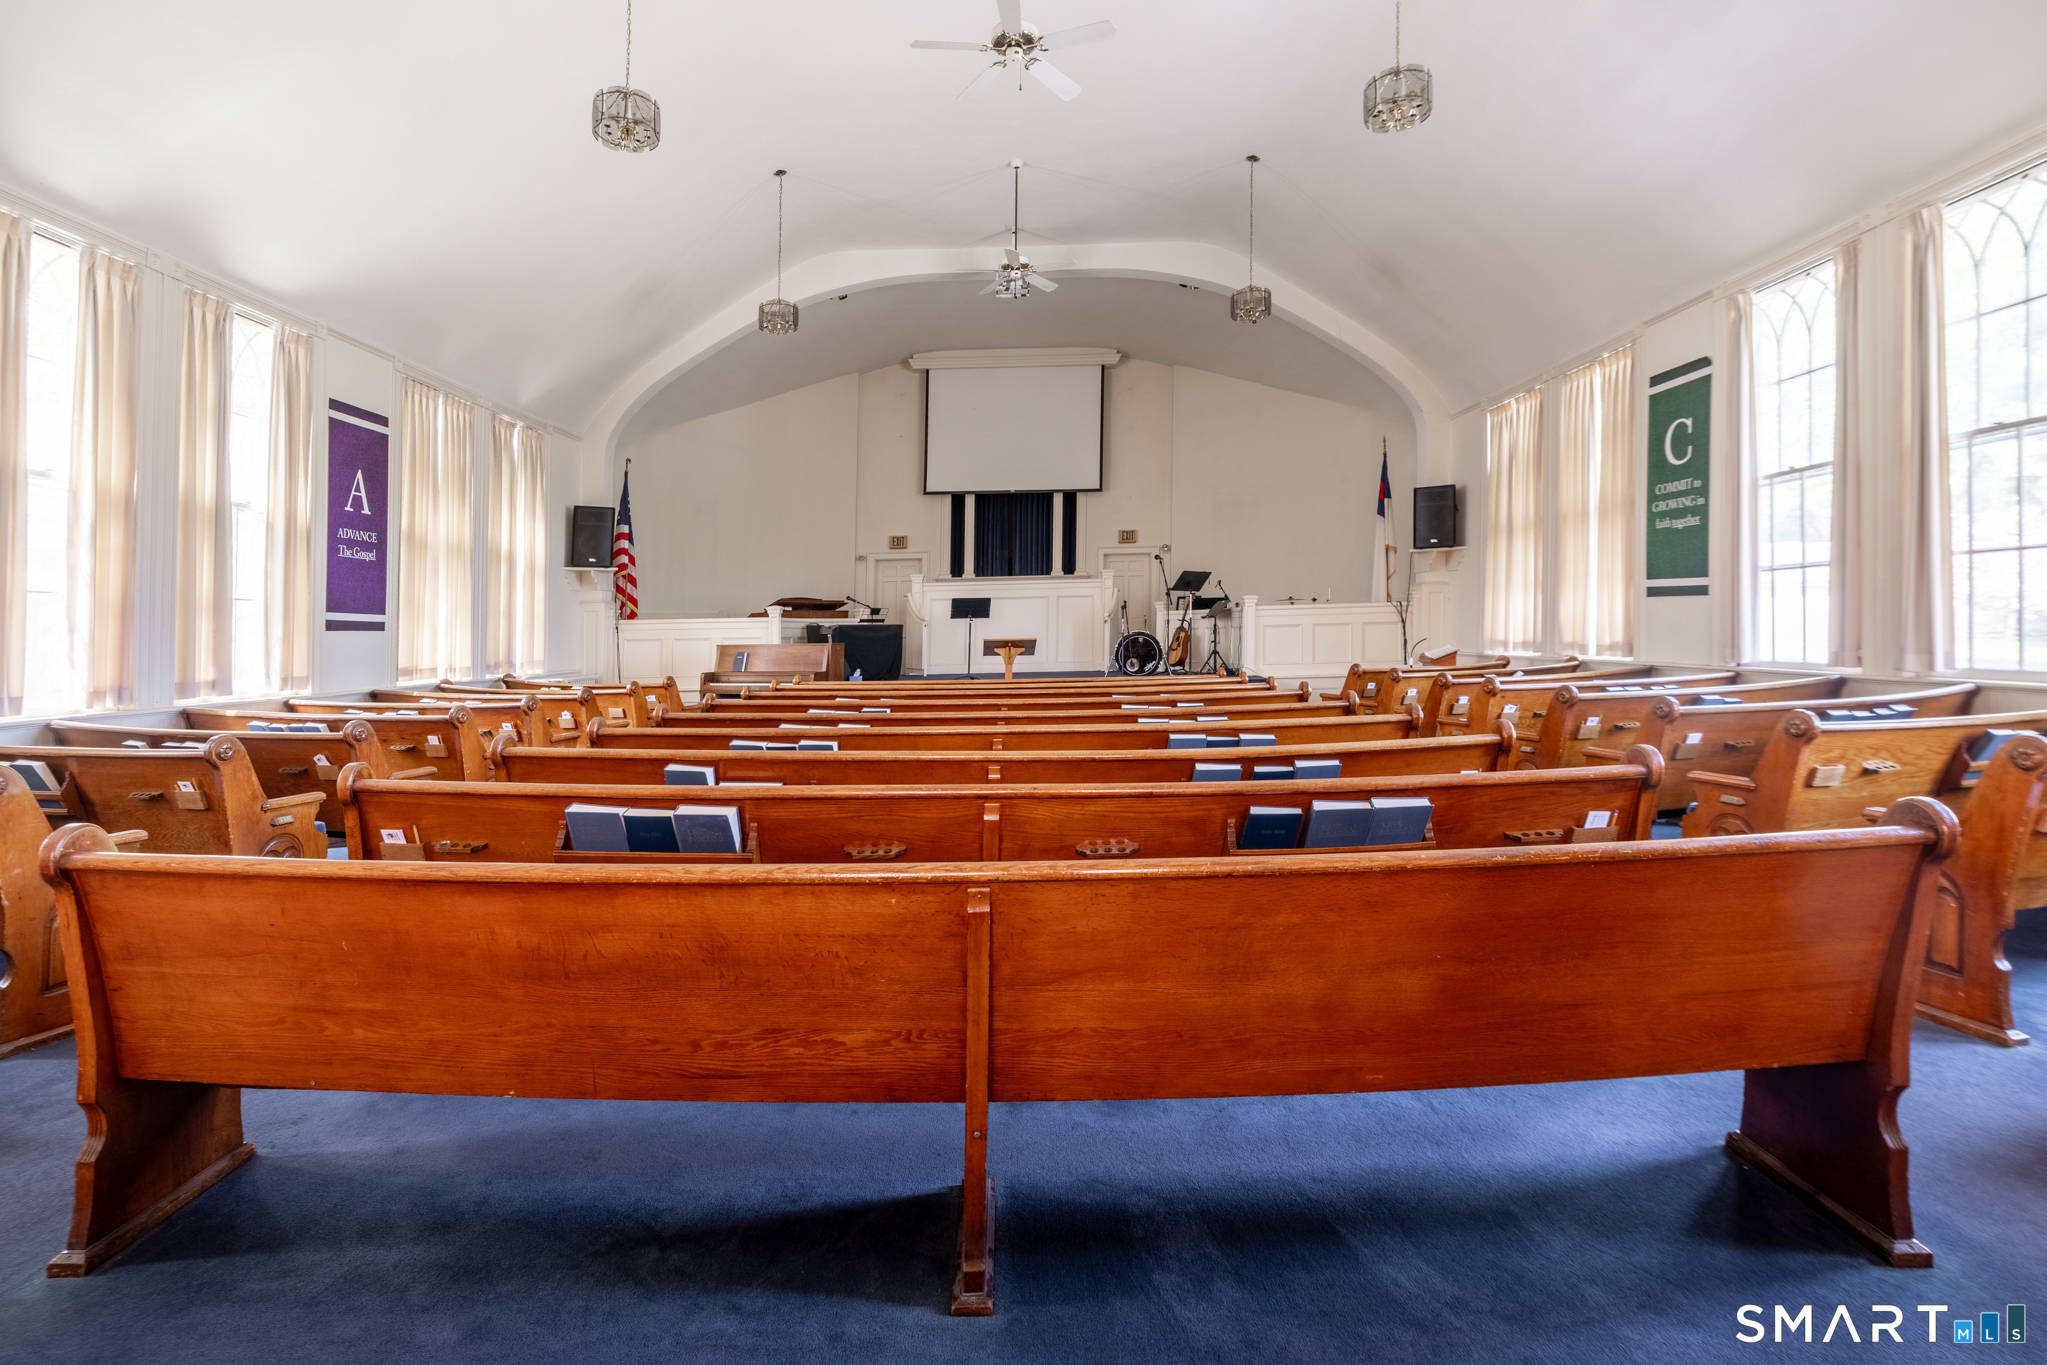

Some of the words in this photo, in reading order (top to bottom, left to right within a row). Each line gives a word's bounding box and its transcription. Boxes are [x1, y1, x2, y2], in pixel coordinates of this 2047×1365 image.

[1664, 417, 1693, 466] C
[344, 468, 372, 515] A
[1655, 477, 1694, 495] COMMIT
[1693, 479, 1702, 488] to
[1651, 495, 1696, 512] GROWING
[1696, 495, 1706, 505] in
[1655, 517, 1671, 529] faith
[1671, 514, 1701, 530] together
[337, 527, 378, 543] ADVANCE
[892, 536, 905, 547] EXIT
[1121, 530, 1135, 541] EXIT
[338, 544, 353, 557] The
[353, 546, 377, 562] Gospel
